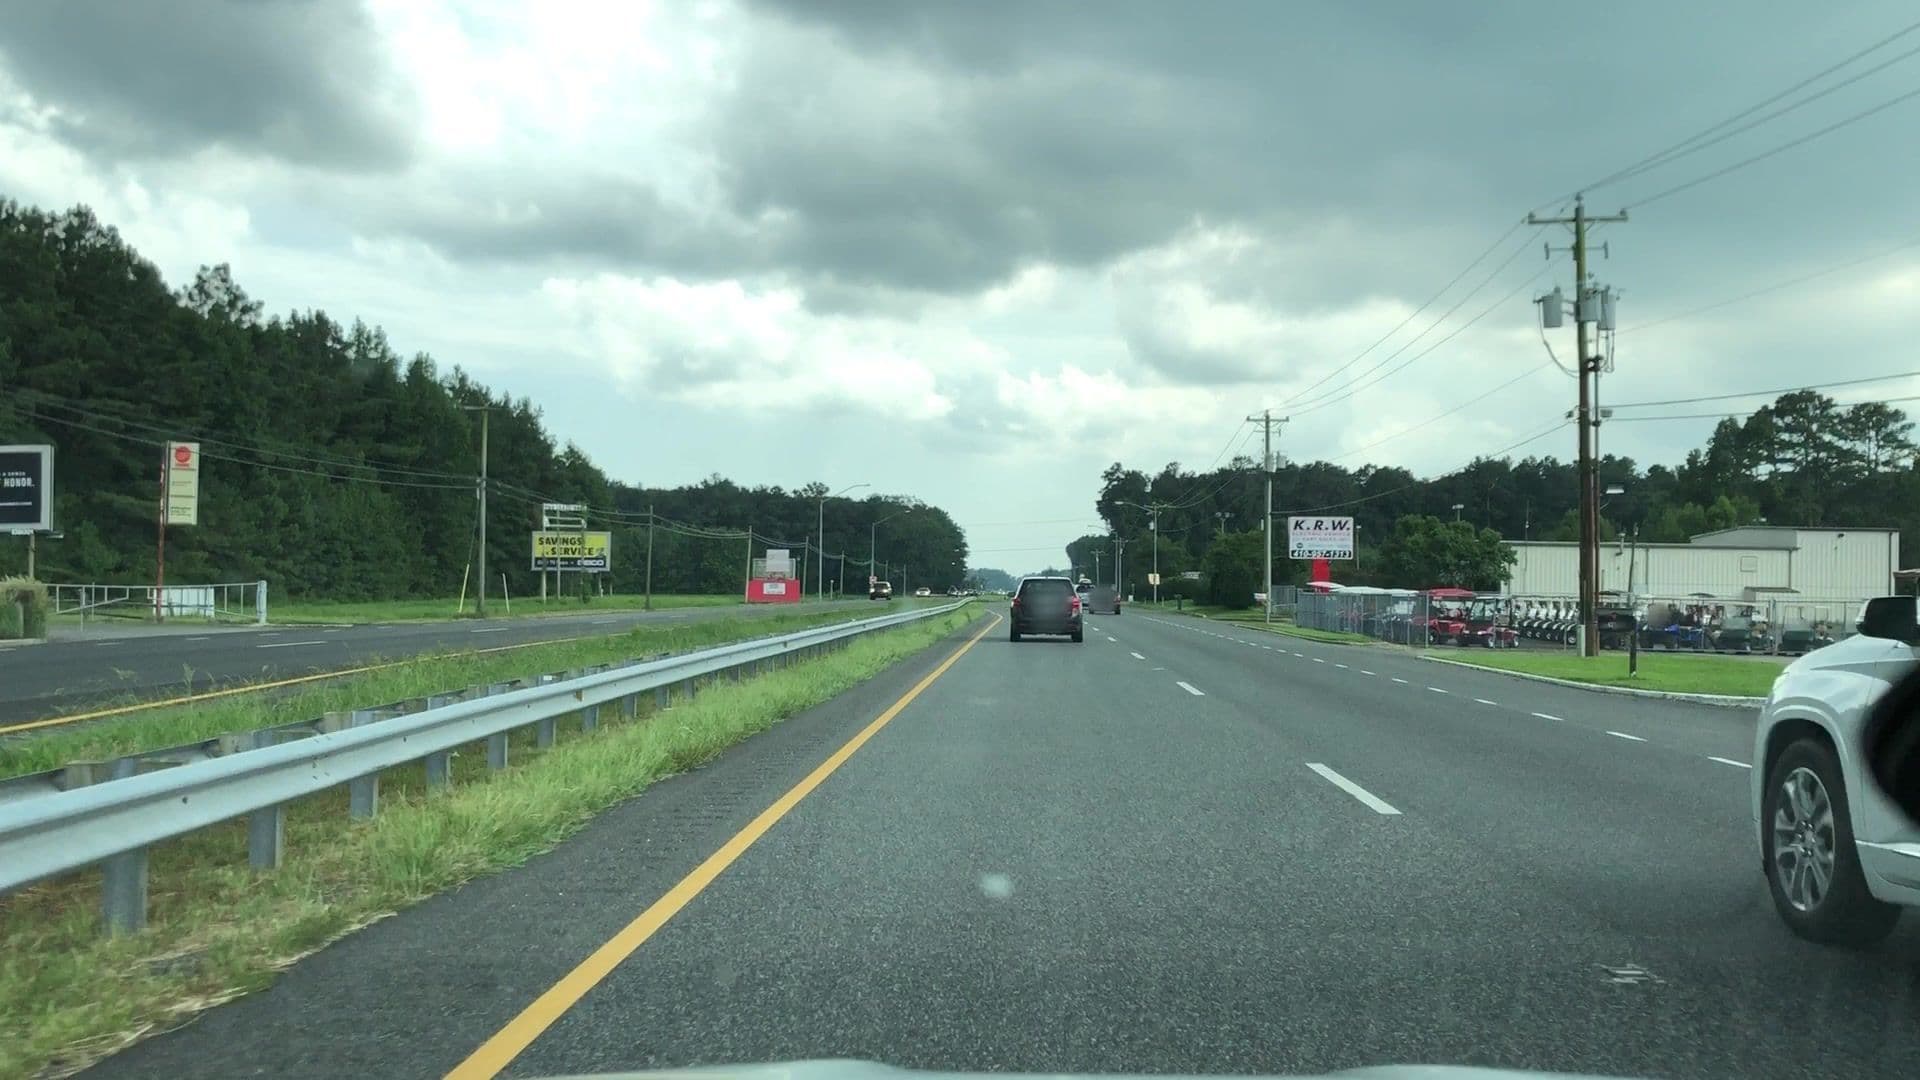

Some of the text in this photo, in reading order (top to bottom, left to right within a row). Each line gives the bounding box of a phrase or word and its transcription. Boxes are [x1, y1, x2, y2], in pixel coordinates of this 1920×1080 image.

[3, 477, 35, 488] HONOR.
[538, 537, 584, 546] SAVINGS
[550, 547, 594, 556] SERVICE
